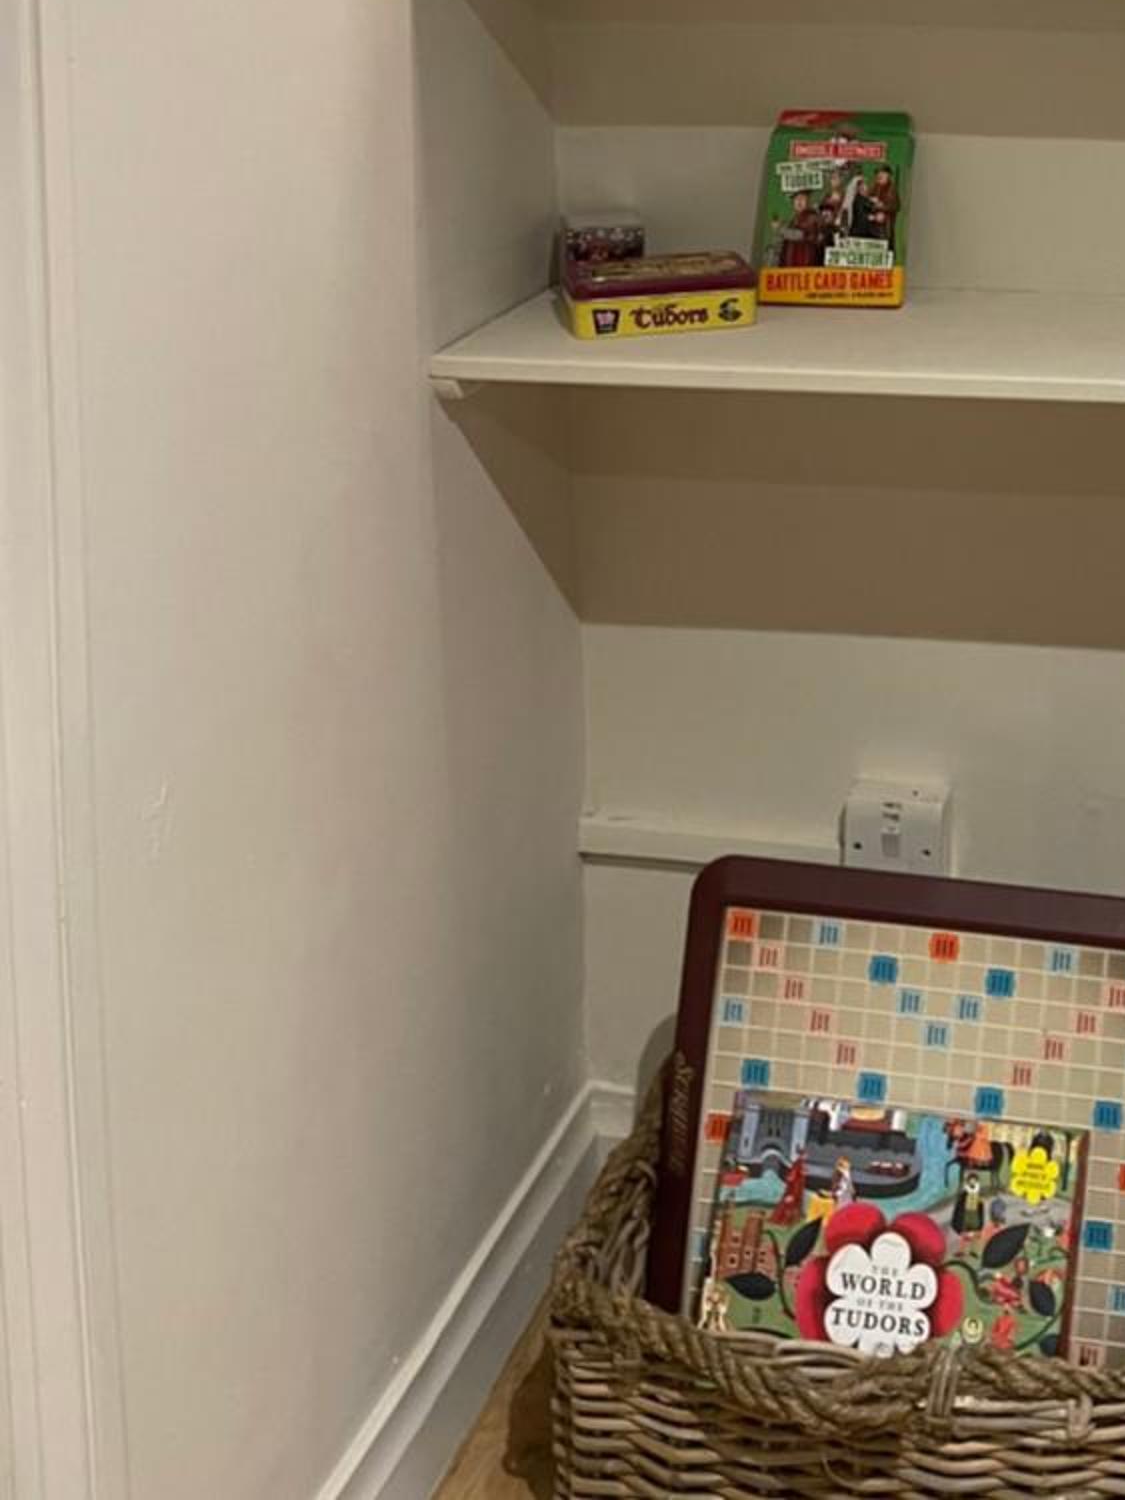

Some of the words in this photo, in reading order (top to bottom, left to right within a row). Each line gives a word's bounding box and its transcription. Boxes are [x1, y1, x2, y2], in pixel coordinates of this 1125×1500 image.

[766, 270, 811, 291] BATTLE
[814, 270, 847, 291] CARD
[850, 268, 894, 290] GAMES
[629, 303, 709, 329] Tudors
[871, 1265, 899, 1277] THE
[841, 1272, 926, 1301] WORLD
[856, 1297, 873, 1309] OF
[880, 1299, 904, 1312] THE
[832, 1307, 926, 1337] TUDORS
